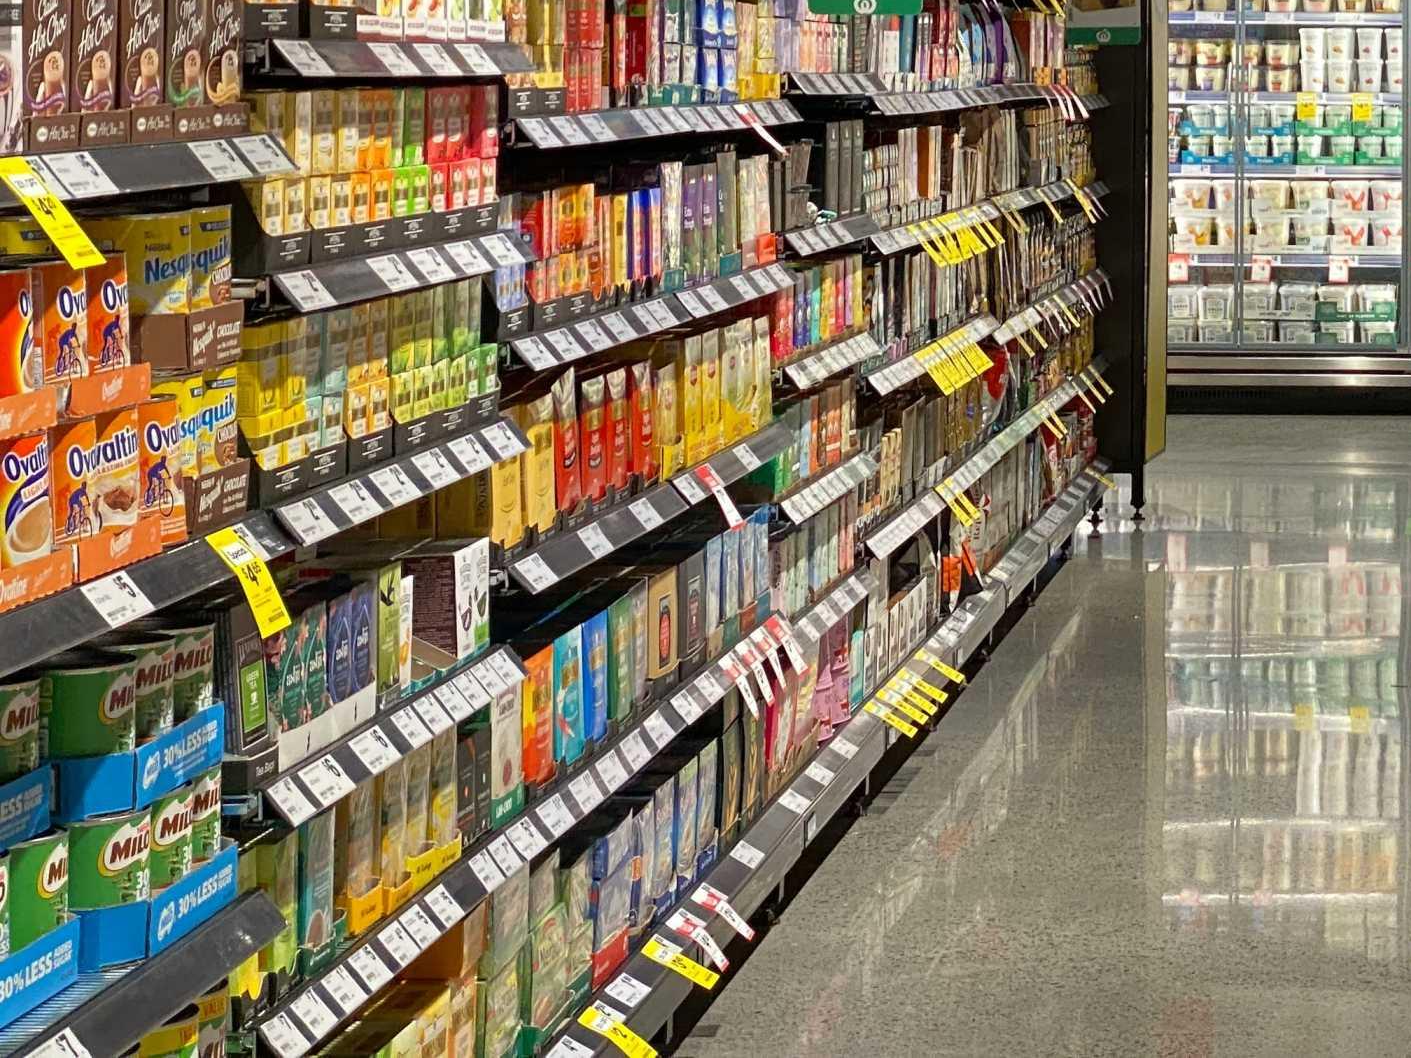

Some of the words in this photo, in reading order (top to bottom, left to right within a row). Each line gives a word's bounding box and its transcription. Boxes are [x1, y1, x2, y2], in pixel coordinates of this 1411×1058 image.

[181, 730, 202, 757] LESS
[177, 888, 197, 918] 30%
[197, 874, 218, 905] LESS
[24, 951, 52, 986] LESS
